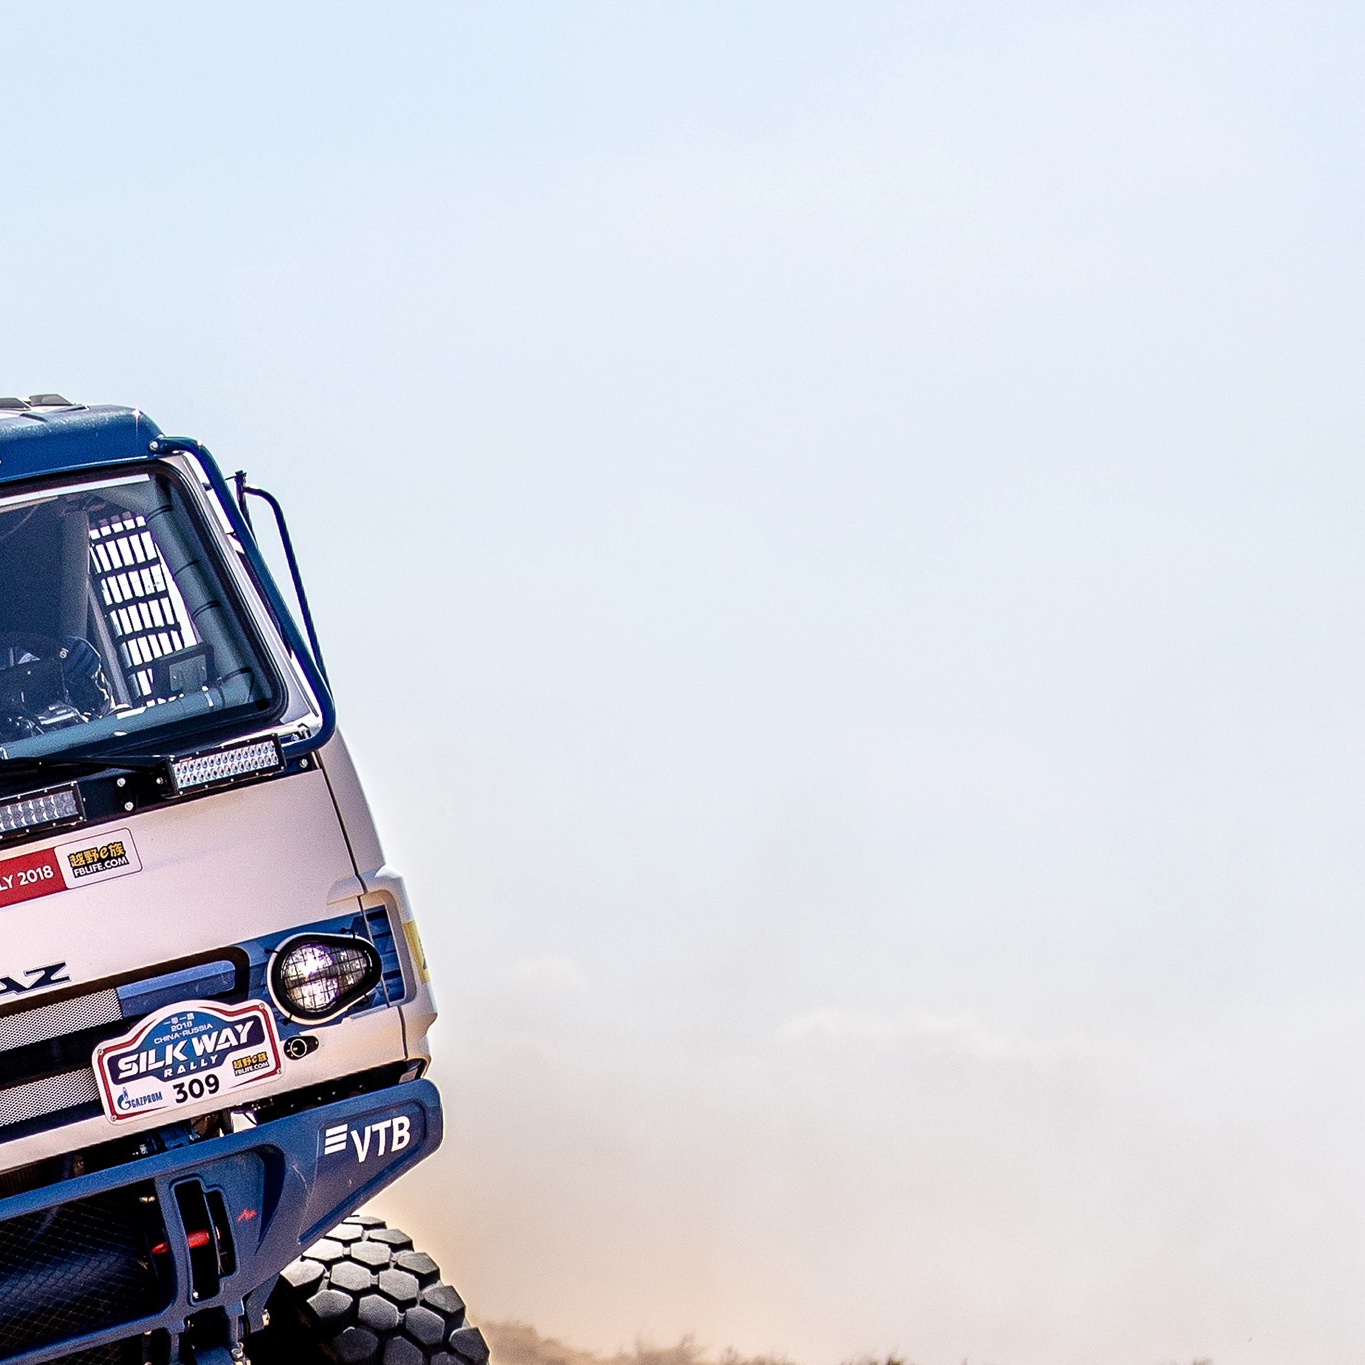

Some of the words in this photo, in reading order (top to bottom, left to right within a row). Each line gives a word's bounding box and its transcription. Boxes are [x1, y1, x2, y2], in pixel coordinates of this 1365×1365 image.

[16, 864, 54, 888] 2018
[73, 857, 128, 877] FBLIFE.COM
[154, 1023, 213, 1045] CHINA-RUSSIA
[170, 1021, 193, 1032] 2018
[118, 1039, 188, 1080] SILK
[191, 1021, 255, 1057] WAY
[163, 1054, 219, 1079] RALLY
[130, 1091, 163, 1109] GAZPROM
[173, 1074, 220, 1104] 309
[349, 1115, 411, 1164] VTB
